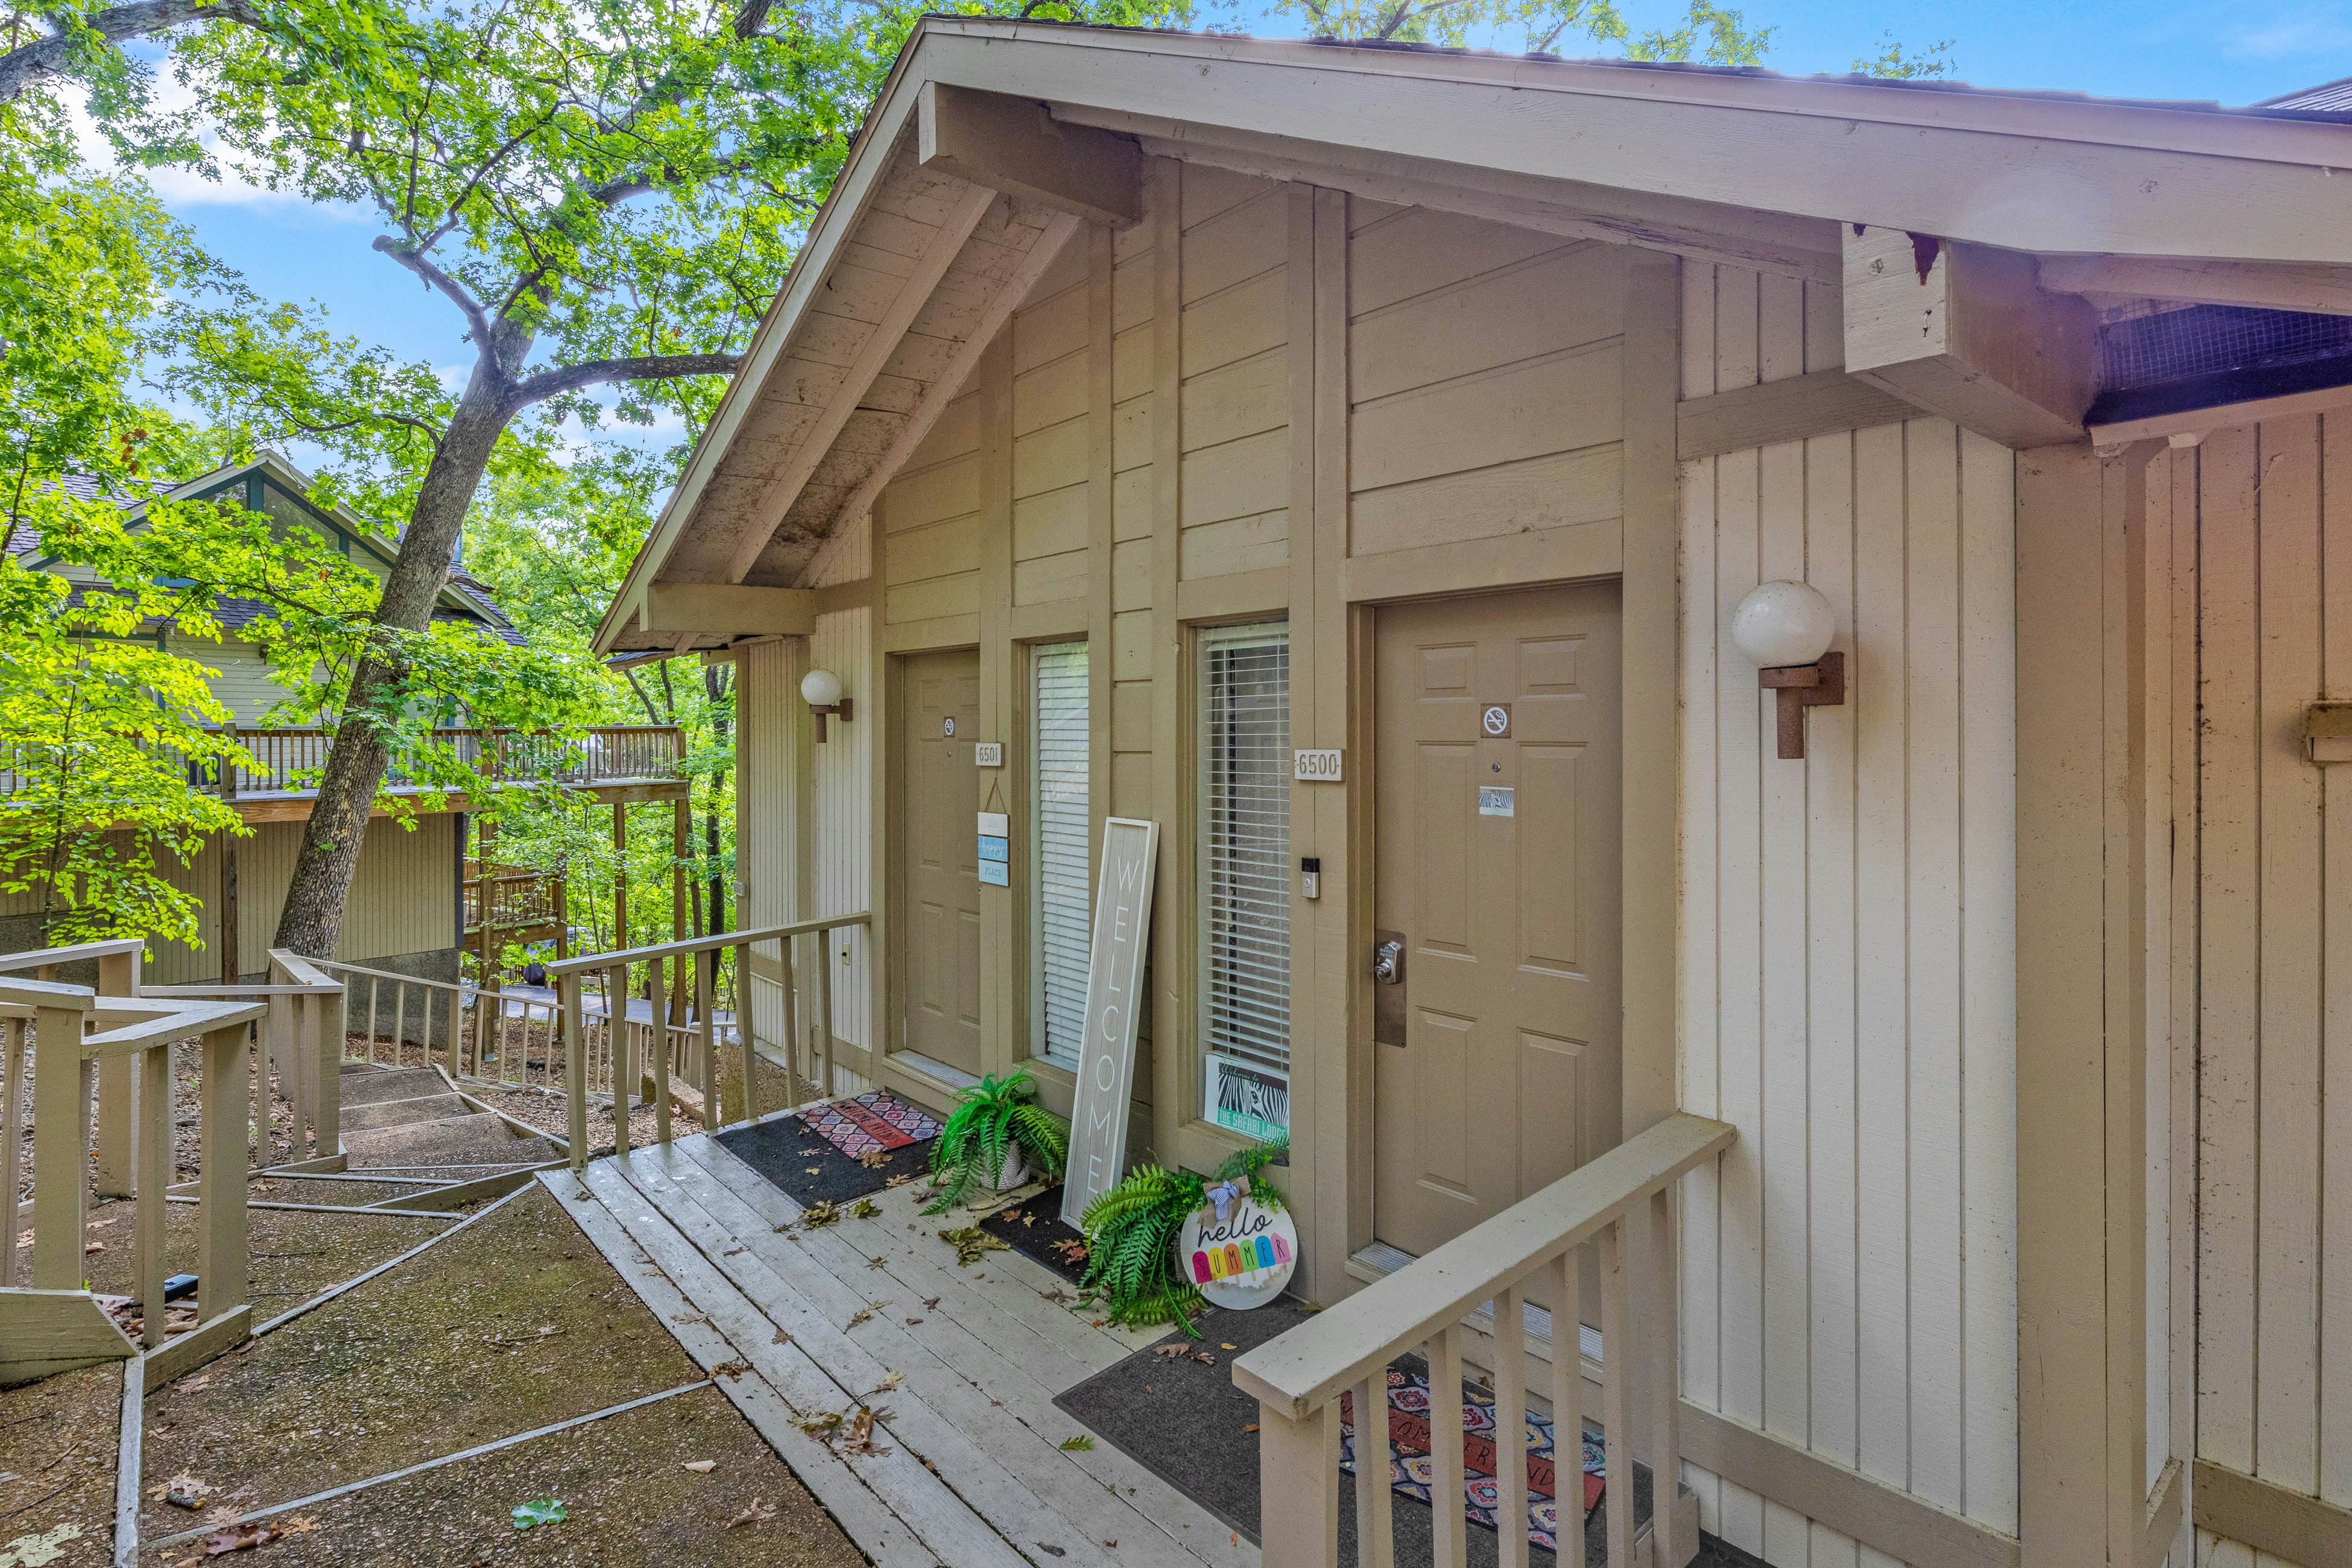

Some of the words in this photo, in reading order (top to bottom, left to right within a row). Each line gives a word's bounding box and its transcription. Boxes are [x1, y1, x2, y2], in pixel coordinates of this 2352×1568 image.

[979, 747, 997, 762] 6501
[1299, 754, 1337, 775] 6500
[981, 838, 1004, 859] happy
[985, 867, 1001, 877] PLACE
[1087, 856, 1140, 1194] WELCOME
[838, 1100, 878, 1122] WELCOME
[869, 1123, 899, 1143] FRIENDS
[1219, 1110, 1231, 1122] THE
[1233, 1113, 1260, 1134] SAFARI
[1197, 1207, 1272, 1248] hello
[1198, 1239, 1285, 1277] SUMMER
